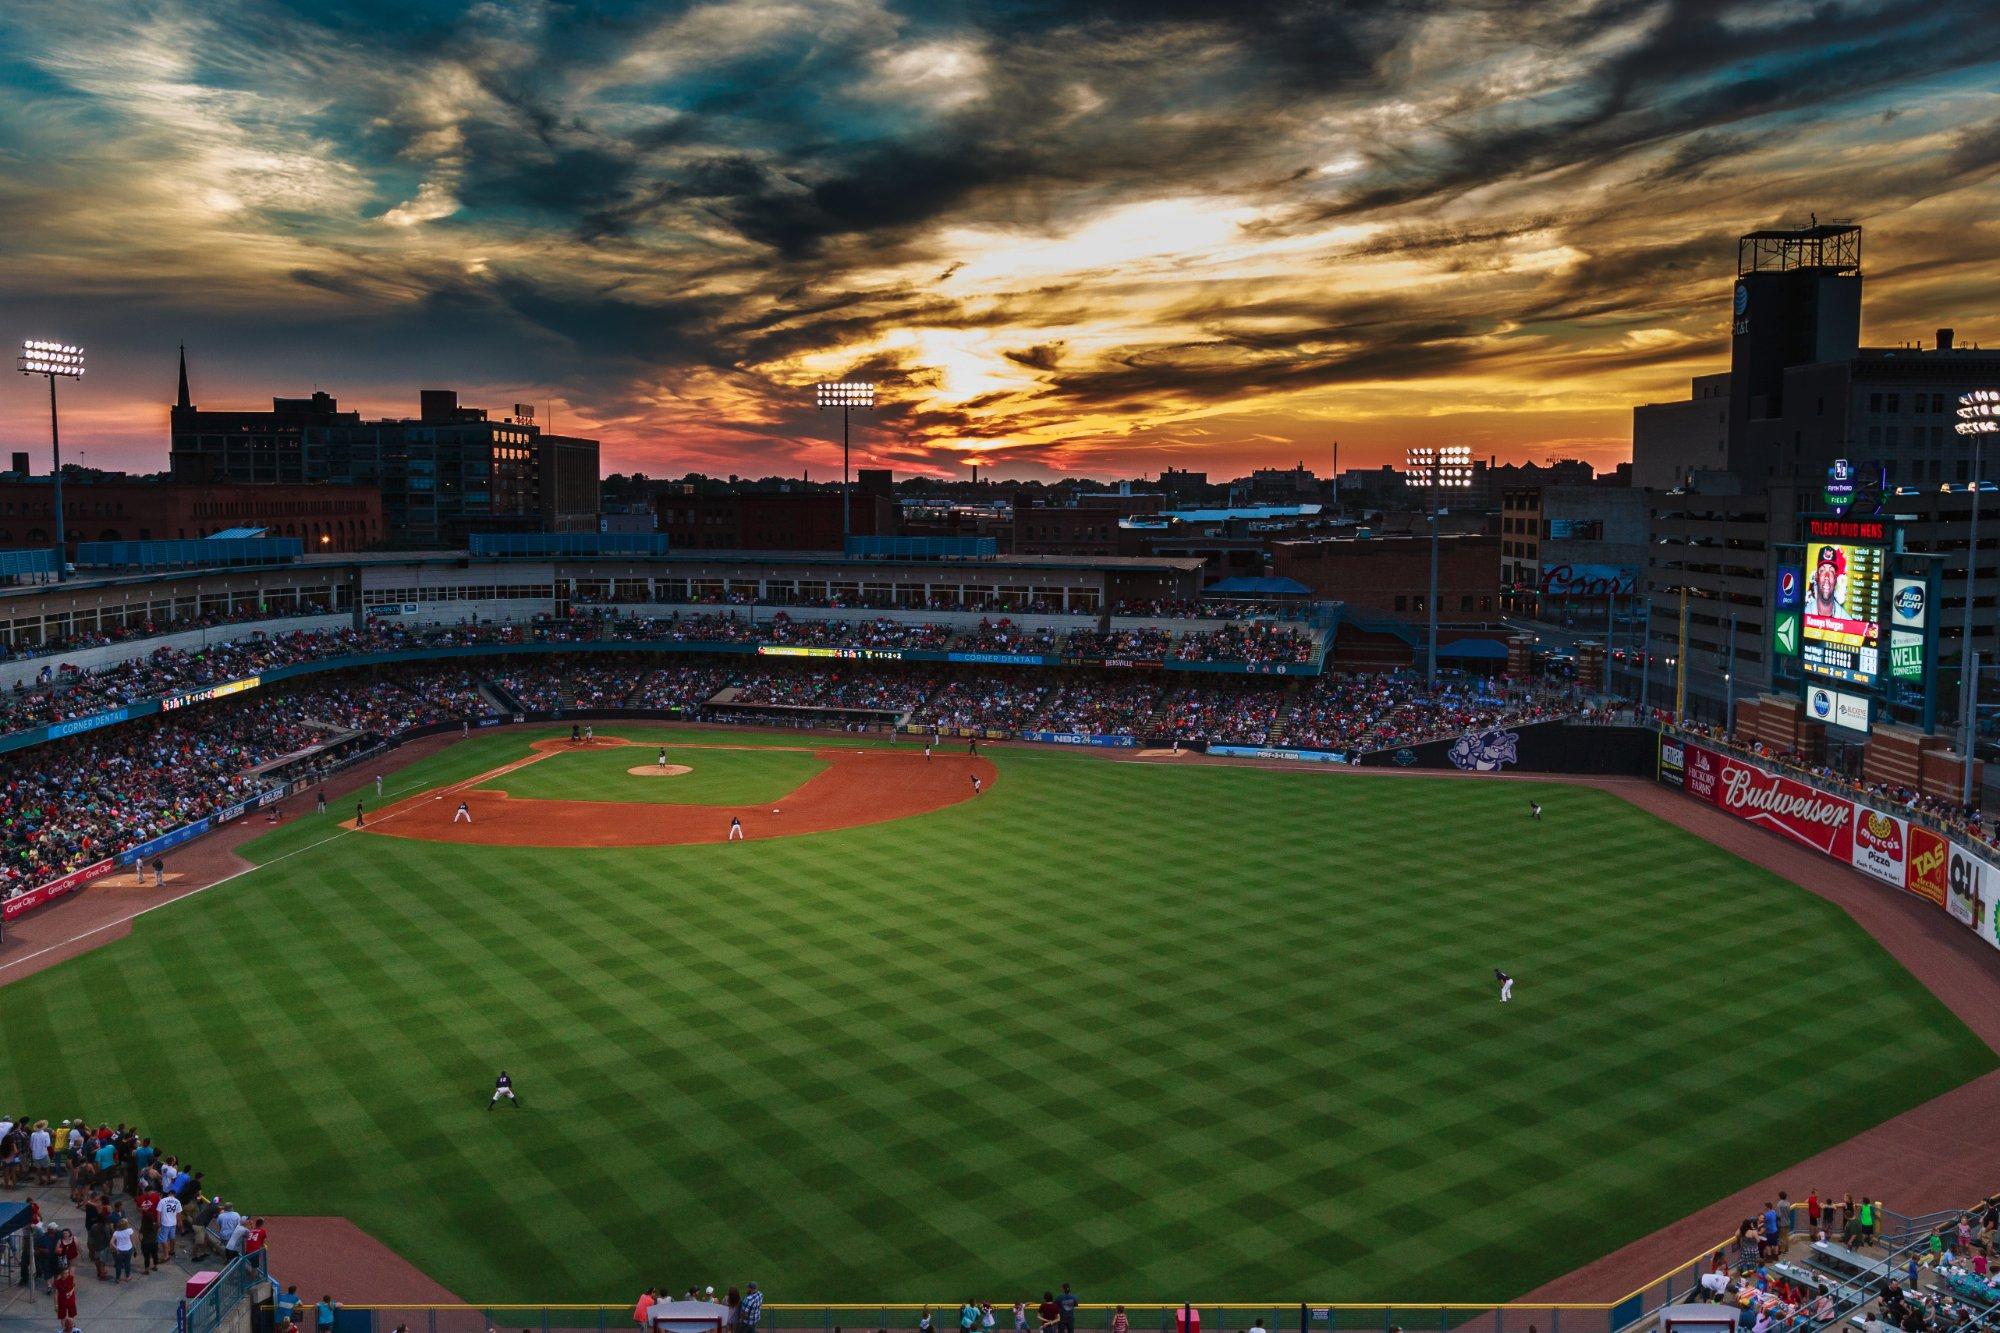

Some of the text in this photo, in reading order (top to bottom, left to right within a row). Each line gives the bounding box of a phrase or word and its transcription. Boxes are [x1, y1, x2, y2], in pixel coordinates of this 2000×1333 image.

[1811, 521, 1883, 539] TOLEDO MUD HENS
[1898, 600, 1923, 610] LIGHT
[1902, 592, 1921, 602] BUD
[964, 654, 1036, 663] CORNER DENTAL
[1105, 659, 1132, 667] HENSVILLE
[1891, 646, 1922, 667] WELL
[1893, 665, 1921, 676] CONNECTED
[62, 710, 124, 734] CORNER DENTAL
[1122, 736, 1132, 746] 24
[1689, 766, 1716, 786] HICKORY
[1691, 779, 1711, 795] FARMS
[1722, 767, 1849, 827] Budweiser
[1911, 842, 1944, 877] TAS
[86, 864, 112, 879] Great Clips
[48, 879, 76, 895] Great Clips
[6, 895, 36, 913] Great Clips
[166, 1204, 176, 1213] 24
